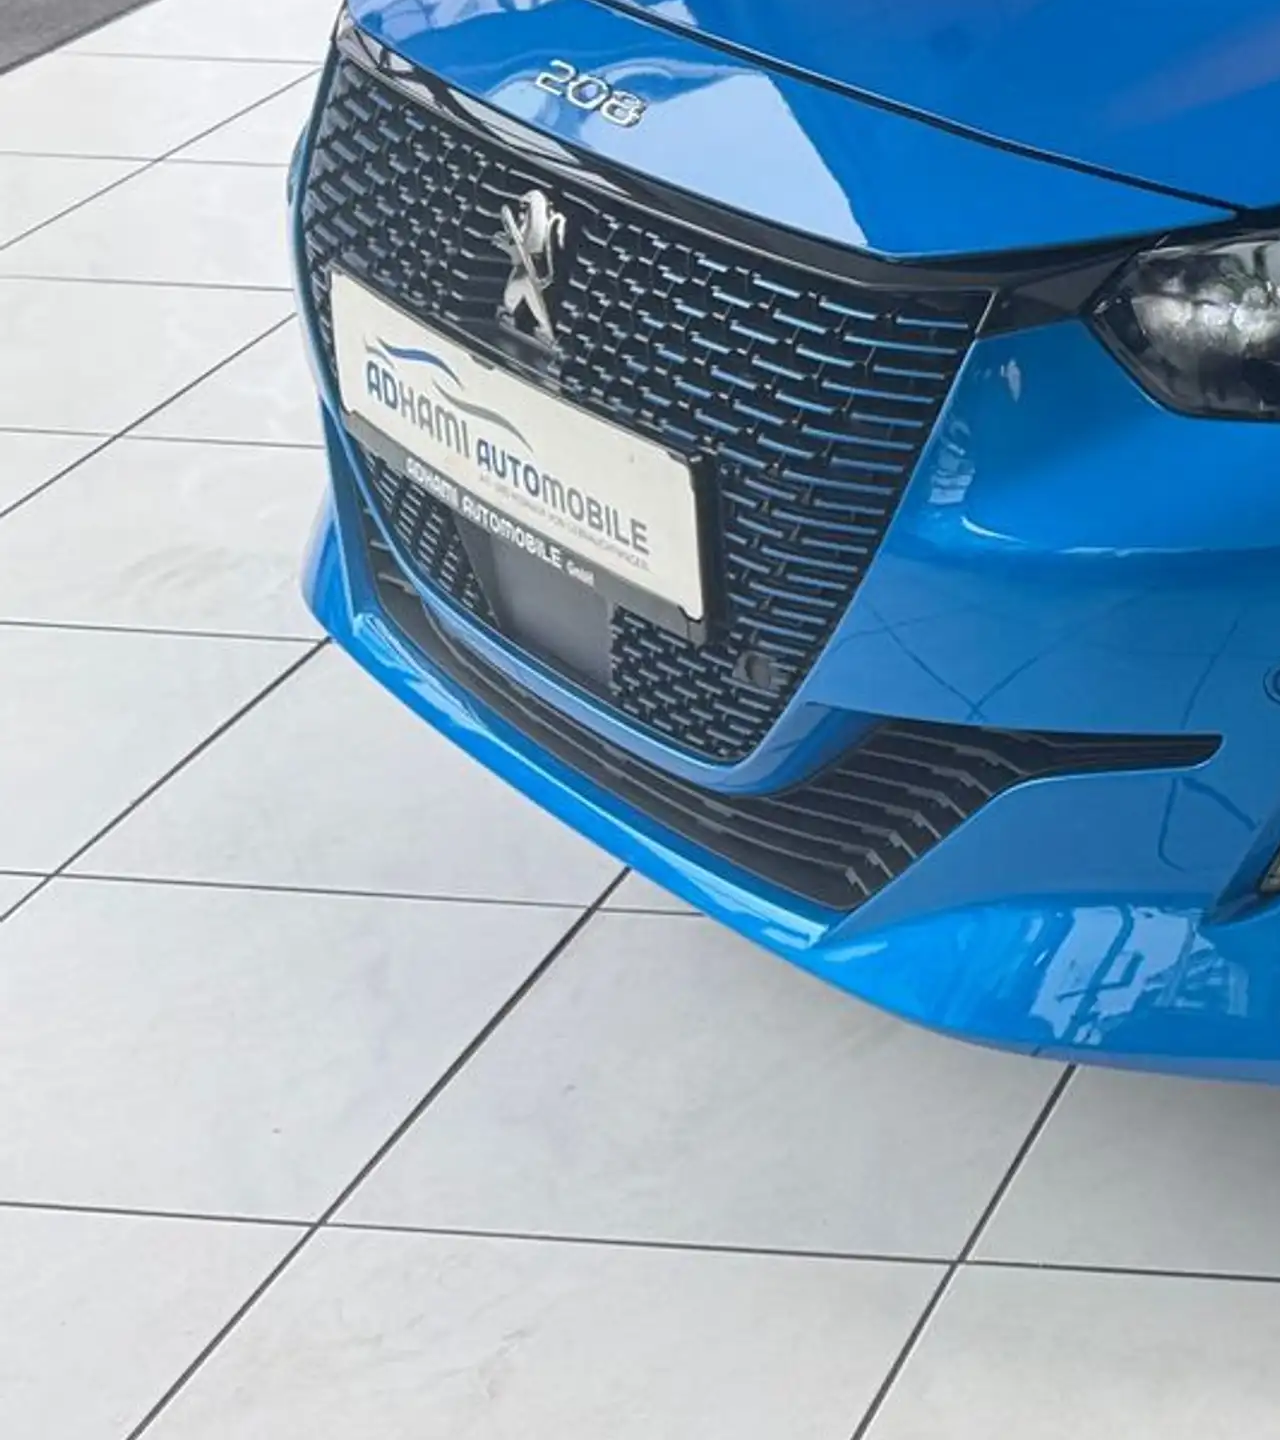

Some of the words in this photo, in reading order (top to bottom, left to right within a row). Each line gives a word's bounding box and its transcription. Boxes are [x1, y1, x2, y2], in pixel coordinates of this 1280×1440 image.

[535, 59, 648, 128] 208
[366, 360, 470, 460] ADHAMI
[476, 439, 651, 556] AUTOMOBILE
[461, 495, 563, 570] AUTOMOBILE
